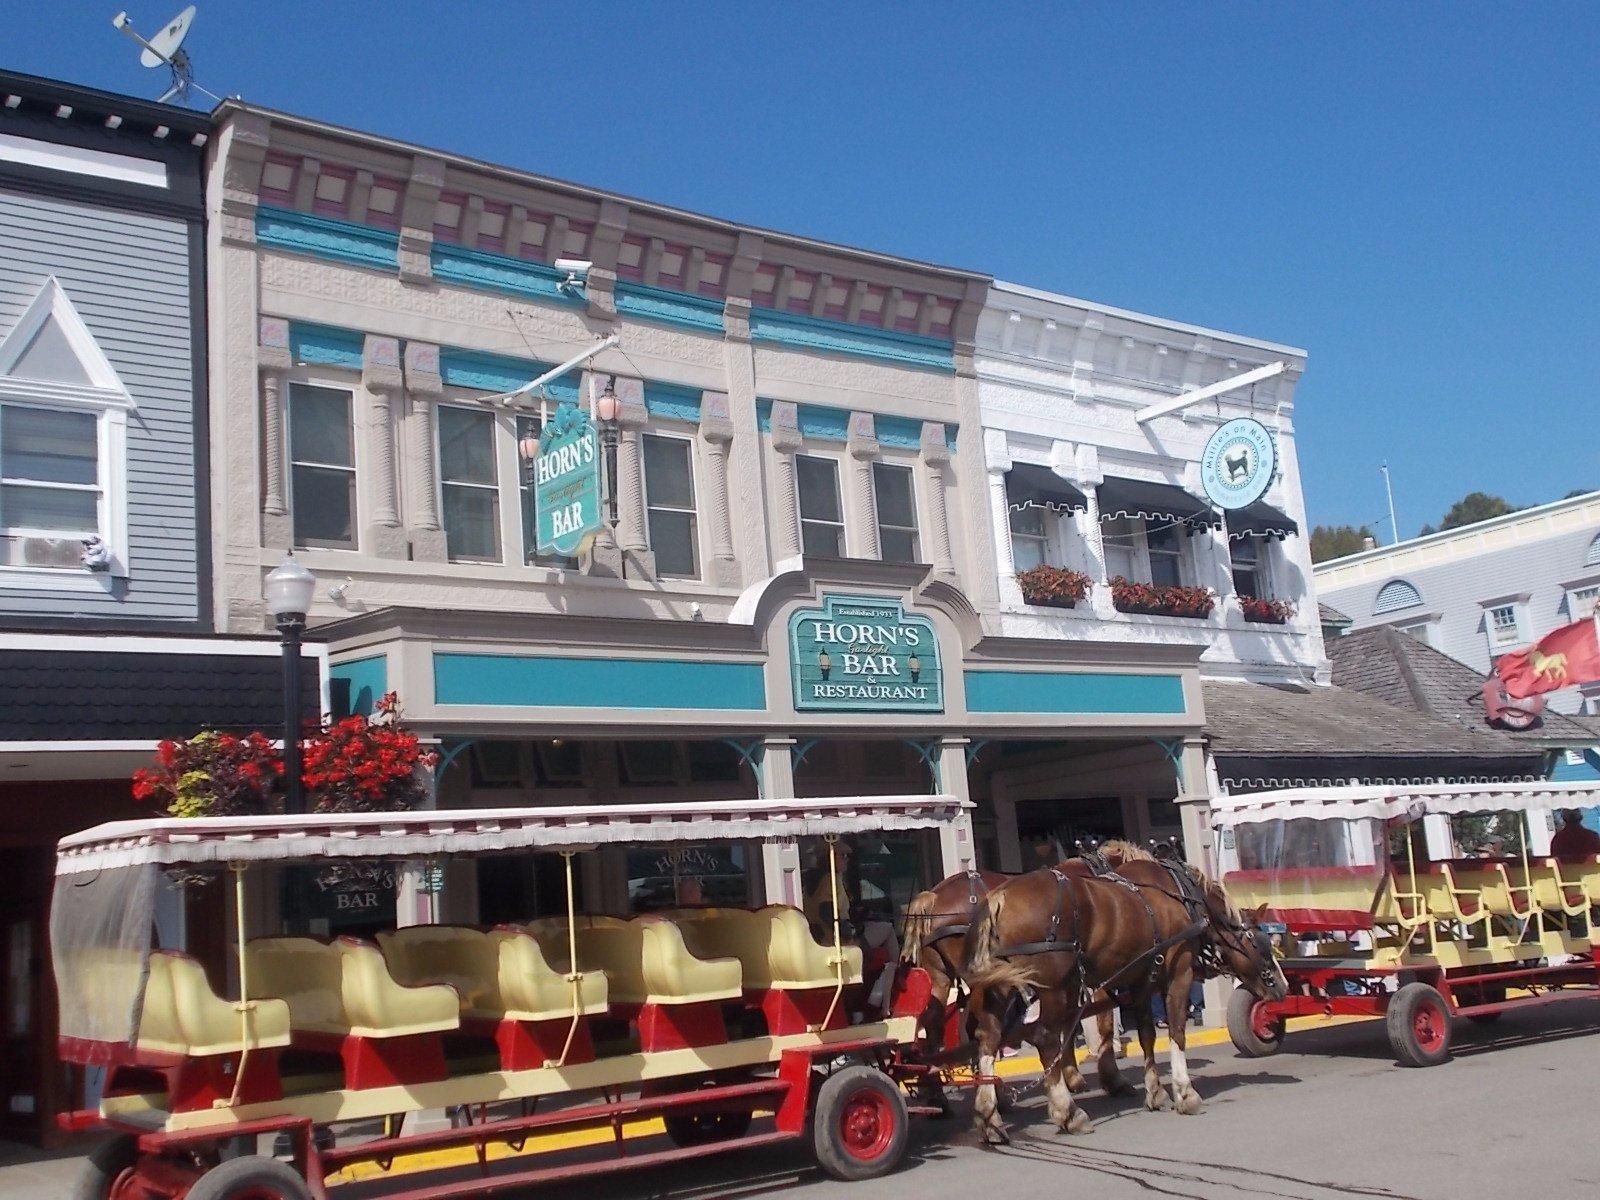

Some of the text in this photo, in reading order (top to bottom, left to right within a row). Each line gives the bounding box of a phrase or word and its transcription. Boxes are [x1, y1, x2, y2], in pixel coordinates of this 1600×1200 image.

[538, 434, 594, 485] HORN'S
[551, 501, 585, 538] BAR
[838, 608, 875, 618] Established
[813, 622, 920, 646] HORN'S
[842, 654, 900, 676] BAR
[866, 675, 877, 684] &
[813, 685, 928, 699] RESTAURANT
[336, 892, 379, 909] BAR
